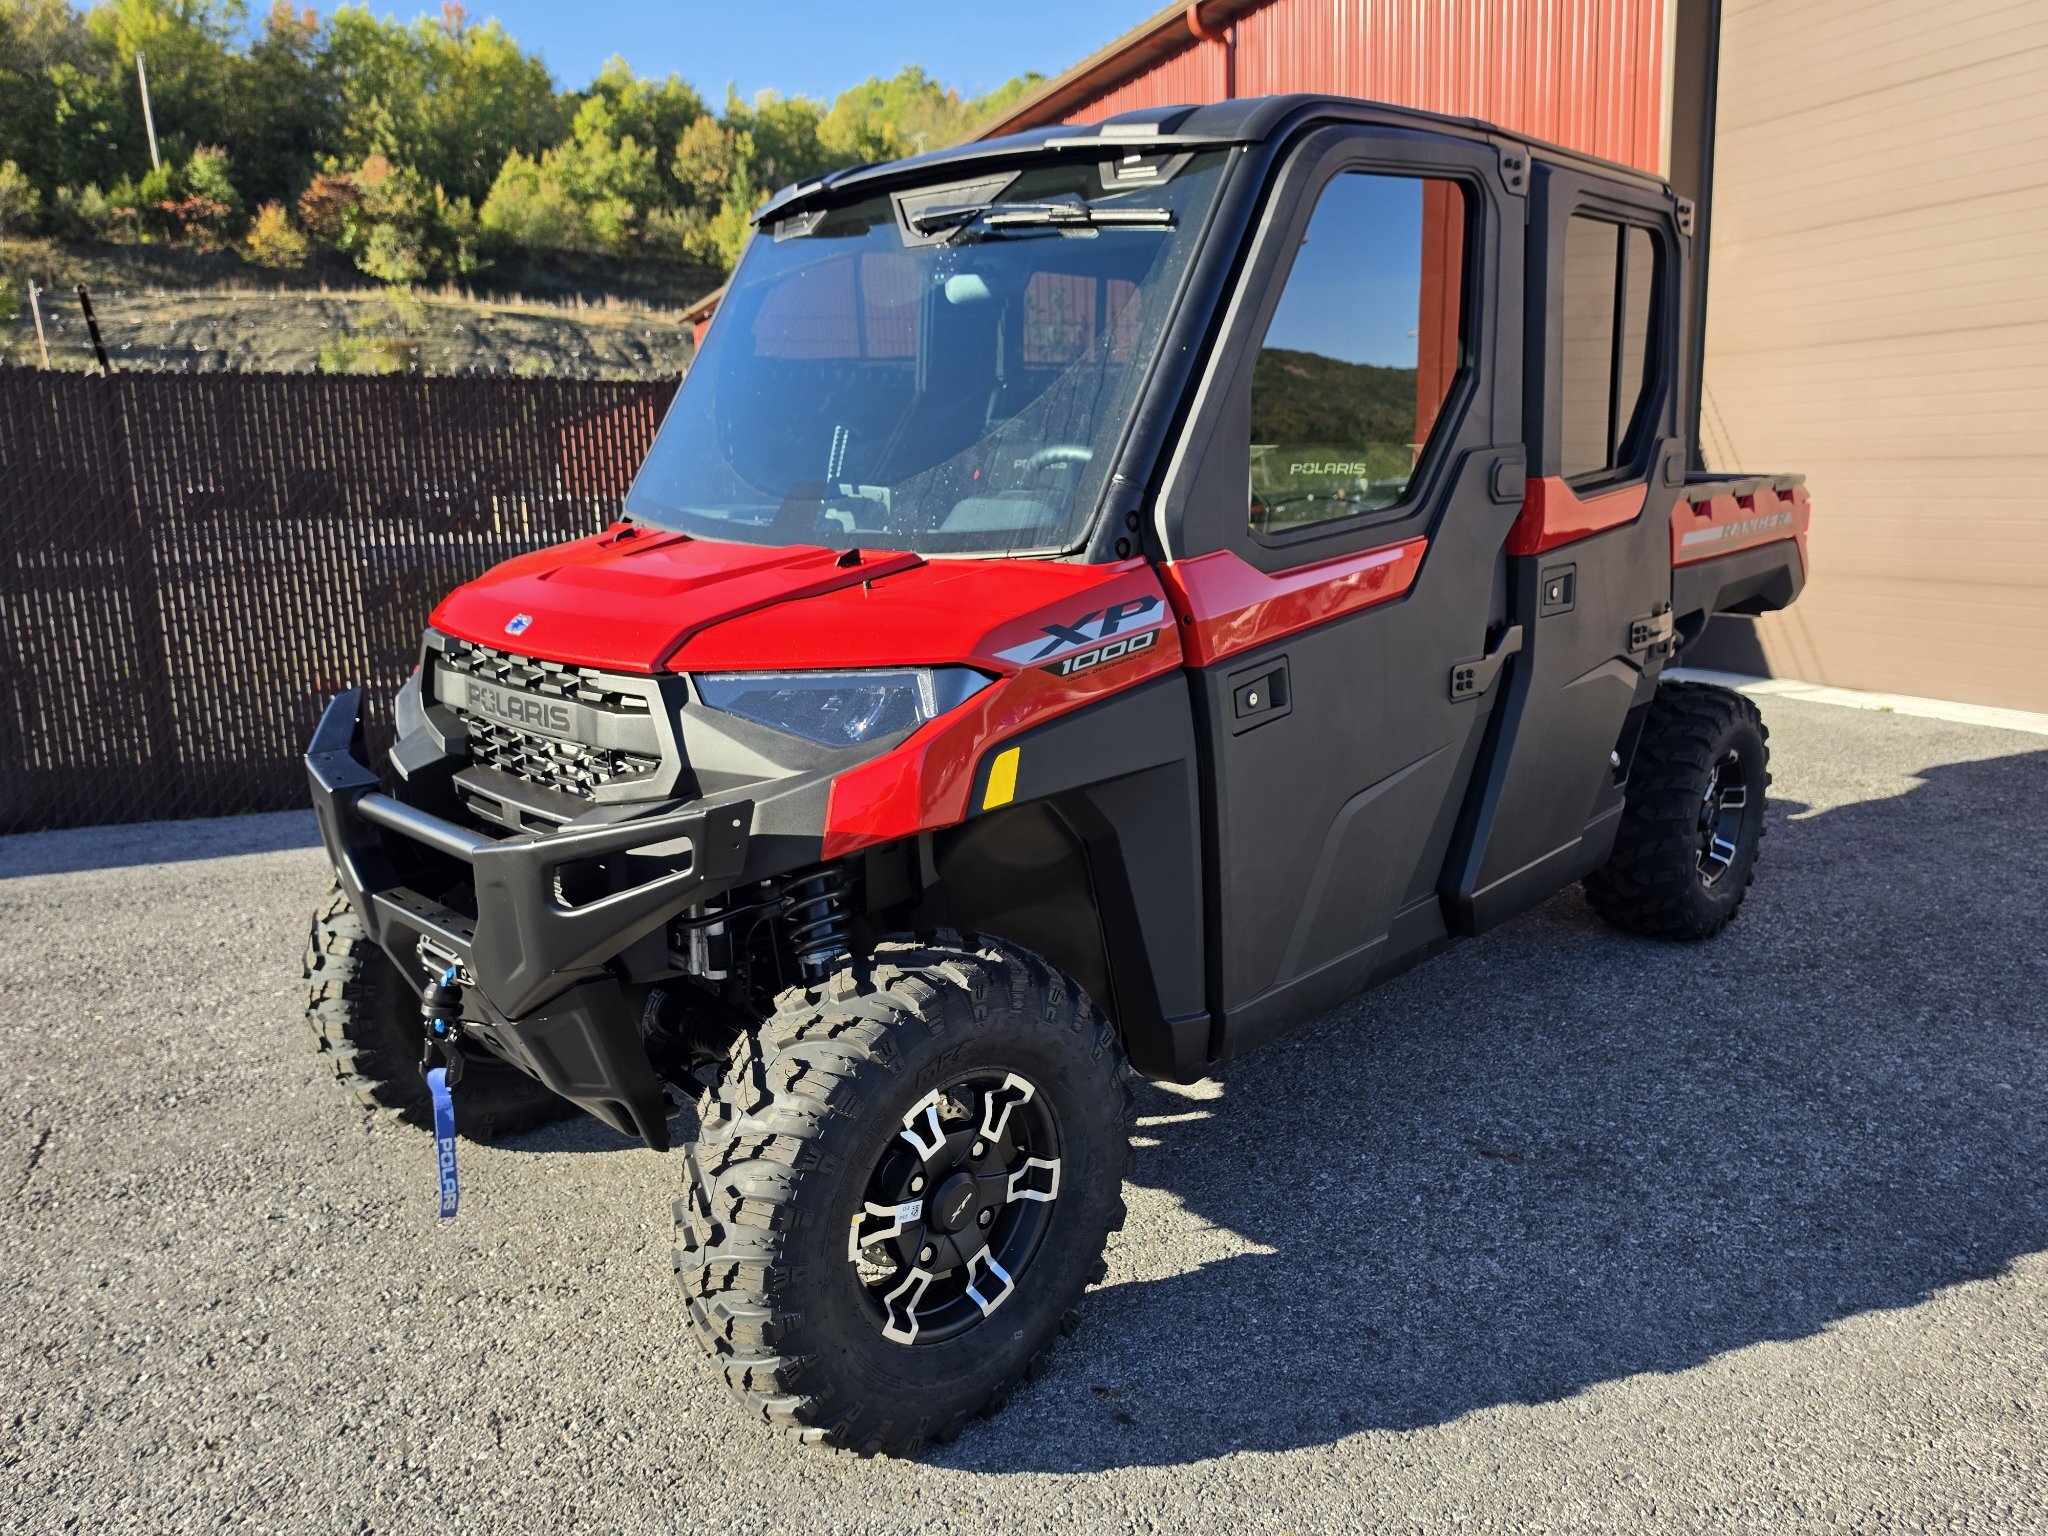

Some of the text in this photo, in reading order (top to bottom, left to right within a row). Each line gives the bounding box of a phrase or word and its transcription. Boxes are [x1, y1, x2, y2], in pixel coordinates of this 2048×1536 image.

[1290, 462, 1366, 475] POLARIS
[1029, 594, 1160, 661] XP
[1061, 631, 1153, 675] 1000
[1092, 655, 1138, 675] OVERHEAD
[468, 682, 570, 732] POLARIS
[439, 1138, 457, 1211] POLARS
